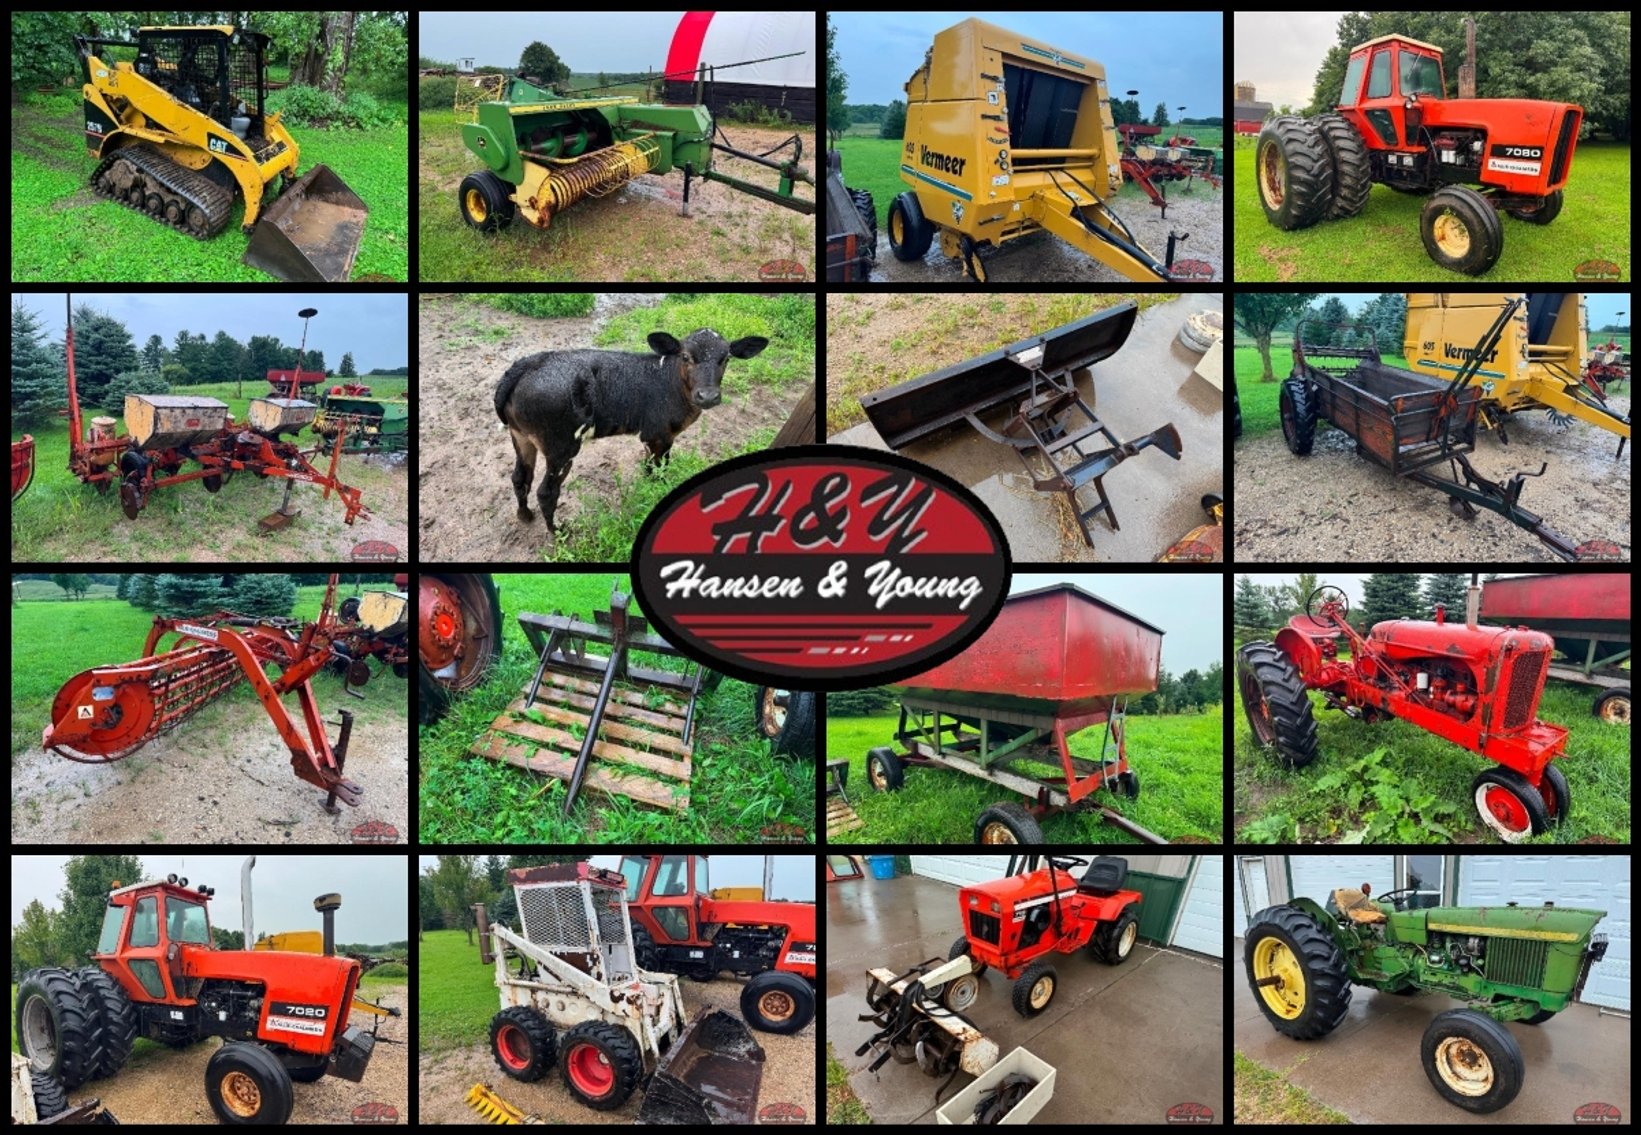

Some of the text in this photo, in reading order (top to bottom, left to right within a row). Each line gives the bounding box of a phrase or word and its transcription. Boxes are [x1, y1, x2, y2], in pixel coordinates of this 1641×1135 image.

[209, 138, 229, 154] CAT
[1505, 147, 1541, 158] 7080
[920, 144, 967, 177] Vermeer
[1444, 342, 1499, 364] Vermr
[286, 1006, 325, 1017] 7020
